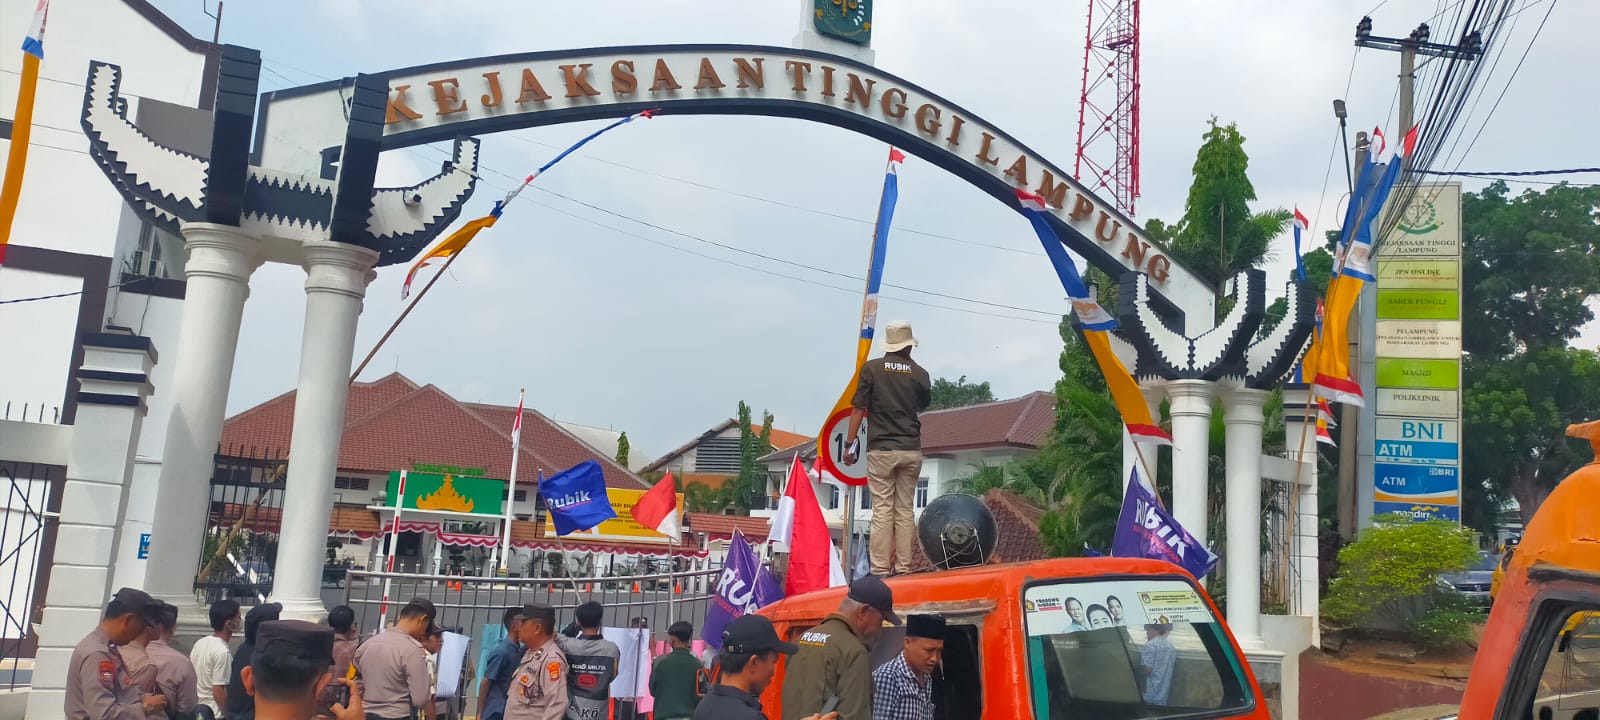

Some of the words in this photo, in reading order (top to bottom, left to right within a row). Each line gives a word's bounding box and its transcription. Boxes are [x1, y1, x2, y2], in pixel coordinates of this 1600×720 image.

[384, 57, 765, 126] KEJAKSAAN
[785, 59, 965, 146] TINGGI
[975, 131, 1171, 284] LAMPUNG
[884, 362, 912, 371] RUBIK
[1401, 369, 1432, 377] MASJID
[1393, 393, 1441, 402] POLIKLINIK
[1402, 421, 1443, 440] BNI
[1379, 443, 1413, 457] ATM
[1438, 468, 1454, 476] BRI
[1381, 476, 1406, 486] ATM
[547, 490, 591, 510] Rubik
[801, 632, 831, 643] RUBIK
